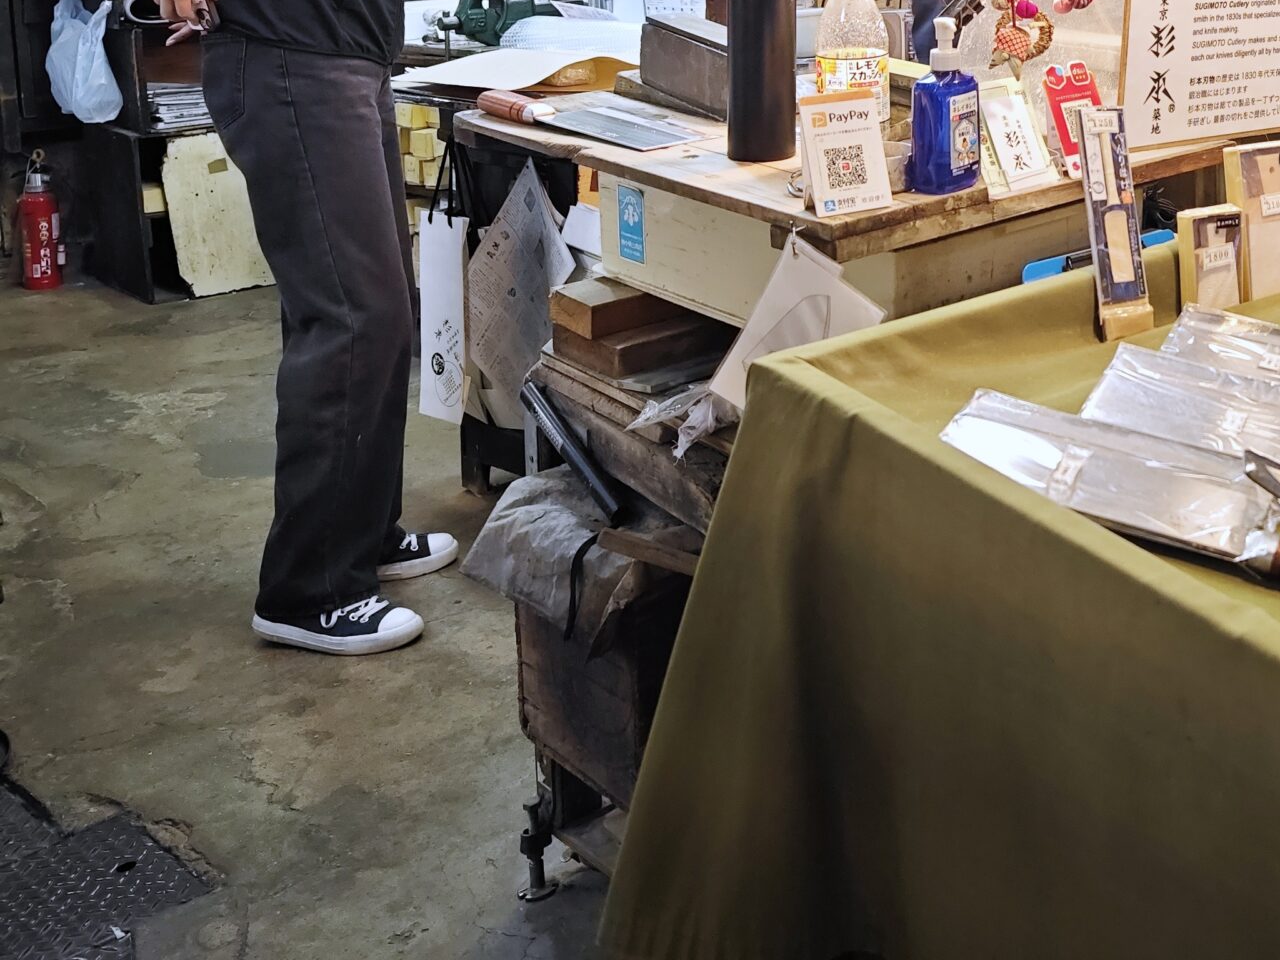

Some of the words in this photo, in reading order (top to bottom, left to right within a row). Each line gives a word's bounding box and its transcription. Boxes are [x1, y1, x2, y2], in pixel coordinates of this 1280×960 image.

[1195, 1, 1227, 10] SUGIMOTO
[1229, 0, 1250, 9] Cutlery
[1193, 15, 1208, 23] smith
[1192, 39, 1225, 49] SUGIMOTO
[1227, 38, 1247, 46] Cutlery
[1248, 36, 1265, 44] makes
[855, 59, 880, 70] レモン
[1241, 71, 1257, 80] 1830
[828, 109, 870, 128] PayPay
[1150, 108, 1162, 135] 築地
